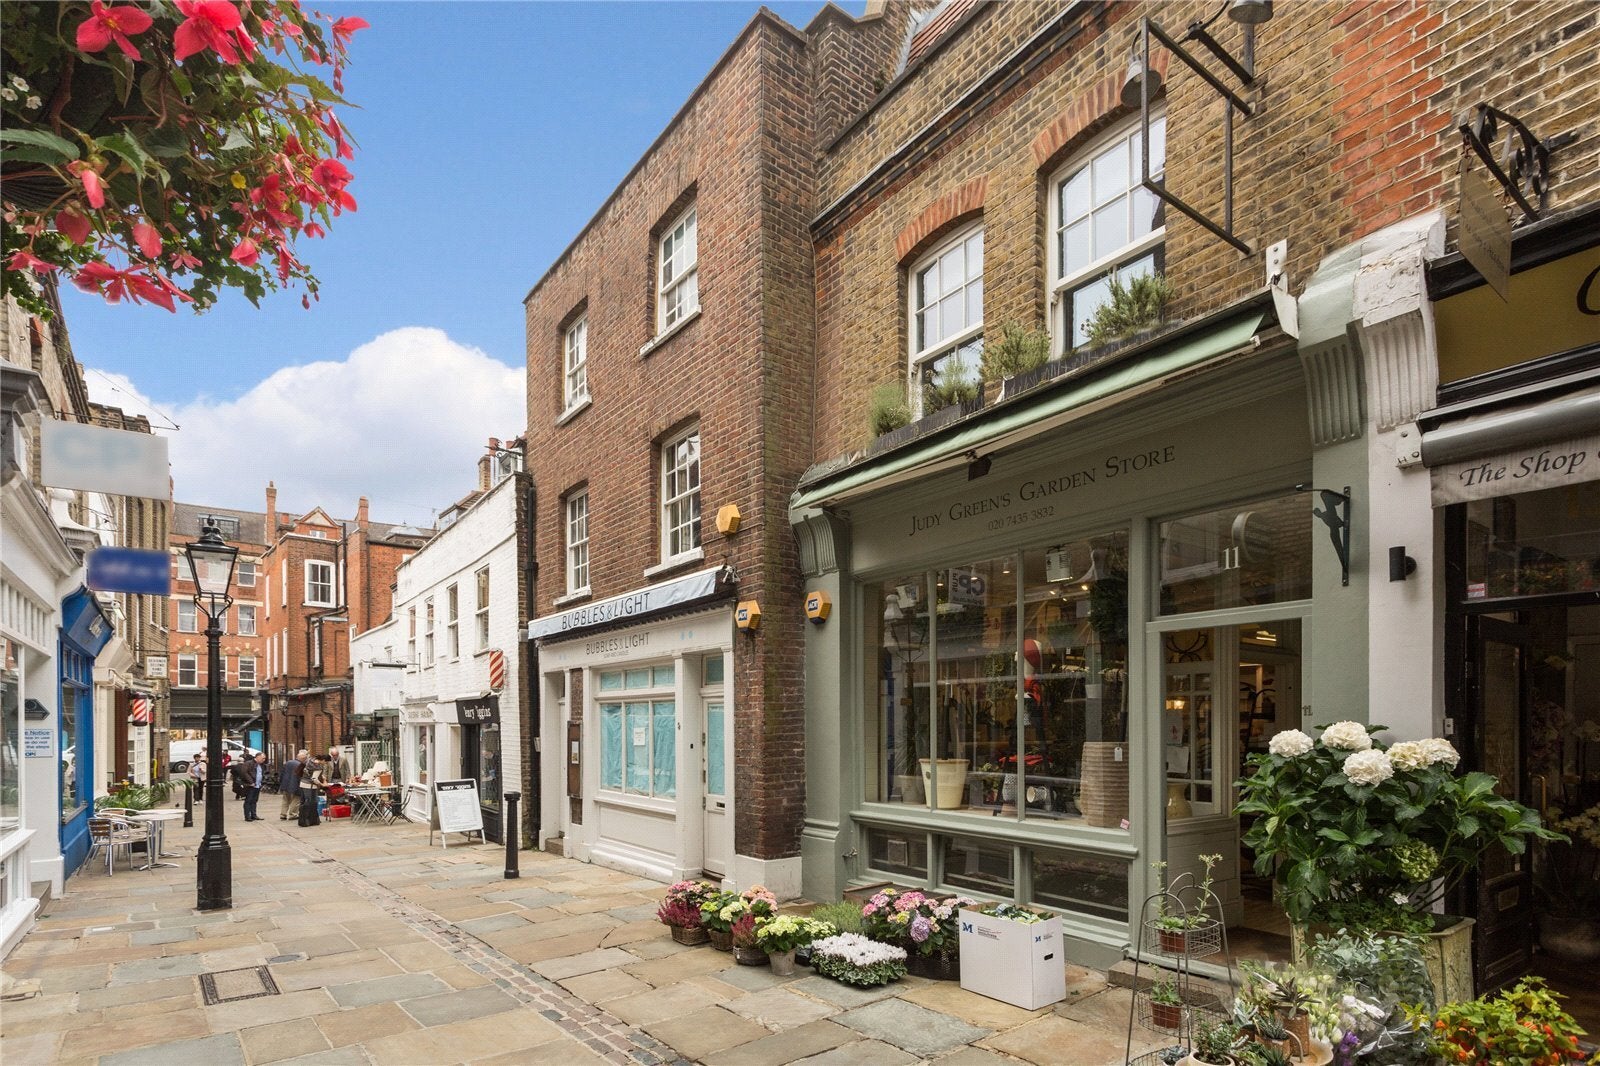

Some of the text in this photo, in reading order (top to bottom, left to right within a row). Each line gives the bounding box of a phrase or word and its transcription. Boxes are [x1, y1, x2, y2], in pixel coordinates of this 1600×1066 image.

[1459, 463, 1506, 487] The
[1513, 450, 1586, 479] Shop
[909, 512, 943, 537] JUDY
[1019, 468, 1096, 501] GARDEN
[1105, 445, 1177, 478] STORE
[987, 505, 1055, 532] 020 7435 3832
[1222, 546, 1241, 570] 11
